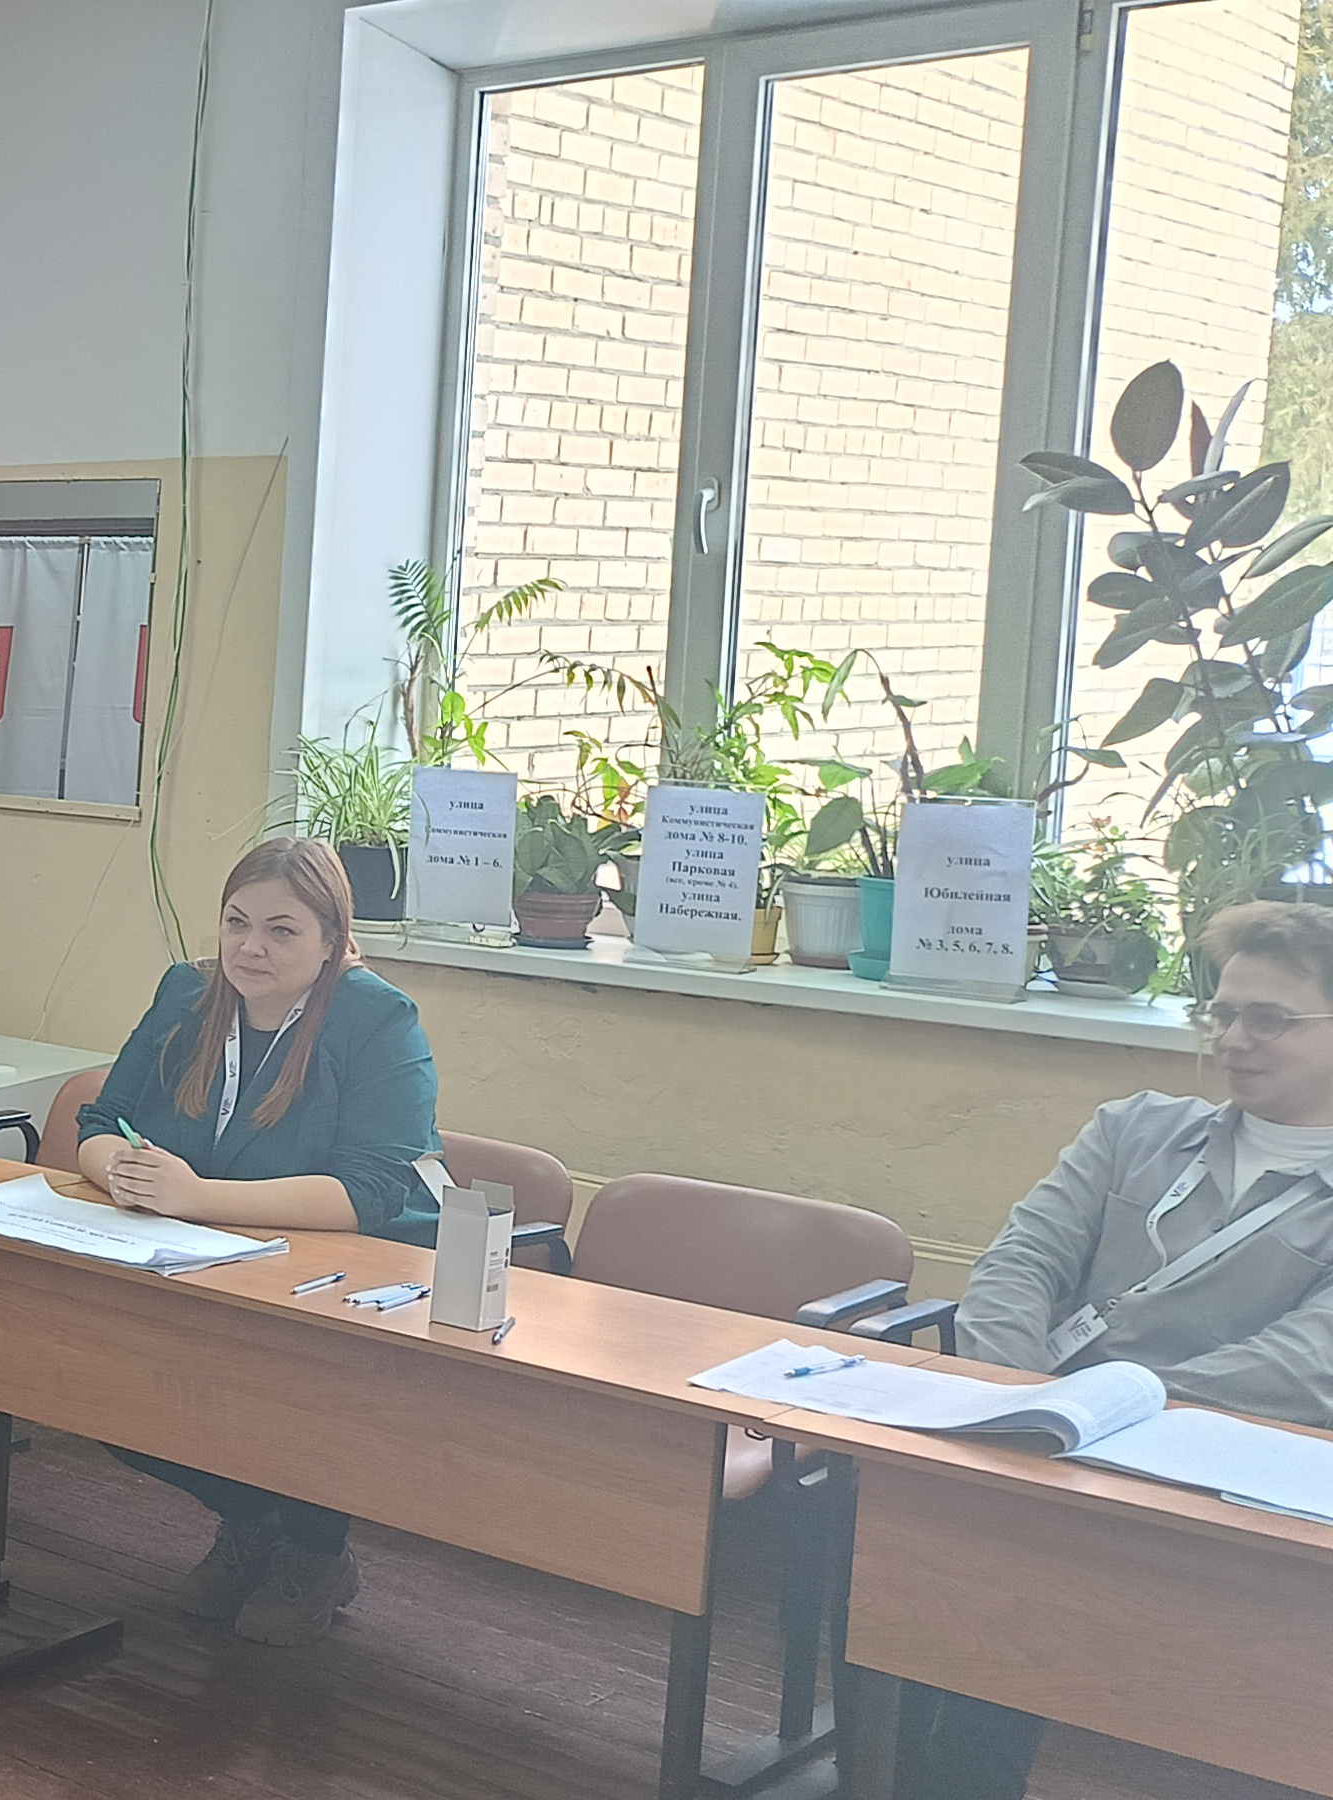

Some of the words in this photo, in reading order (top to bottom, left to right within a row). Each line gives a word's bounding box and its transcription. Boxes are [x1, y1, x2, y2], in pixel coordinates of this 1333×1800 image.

[448, 800, 485, 811] улица
[688, 804, 729, 816] улица
[661, 815, 755, 831] Коммунистическая
[664, 831, 696, 842] дома
[699, 831, 714, 843] №
[717, 833, 748, 846] 8-10.
[684, 848, 724, 860] улица
[426, 855, 455, 865] дома
[457, 855, 471, 866] №
[474, 857, 480, 867] 1
[492, 858, 504, 869] 6.
[946, 856, 991, 868] улица
[671, 861, 736, 878] Парковая
[687, 878, 715, 888] кроме
[680, 891, 721, 903] улица
[924, 886, 1011, 903] Юбилейная
[658, 902, 742, 922] Набережная.
[946, 925, 983, 936] дома
[915, 938, 932, 951] №
[936, 939, 949, 952] 3,
[952, 940, 965, 953] 5,
[968, 942, 981, 954] 6,
[985, 942, 998, 955] 7,
[1001, 943, 1014, 955] 8.
